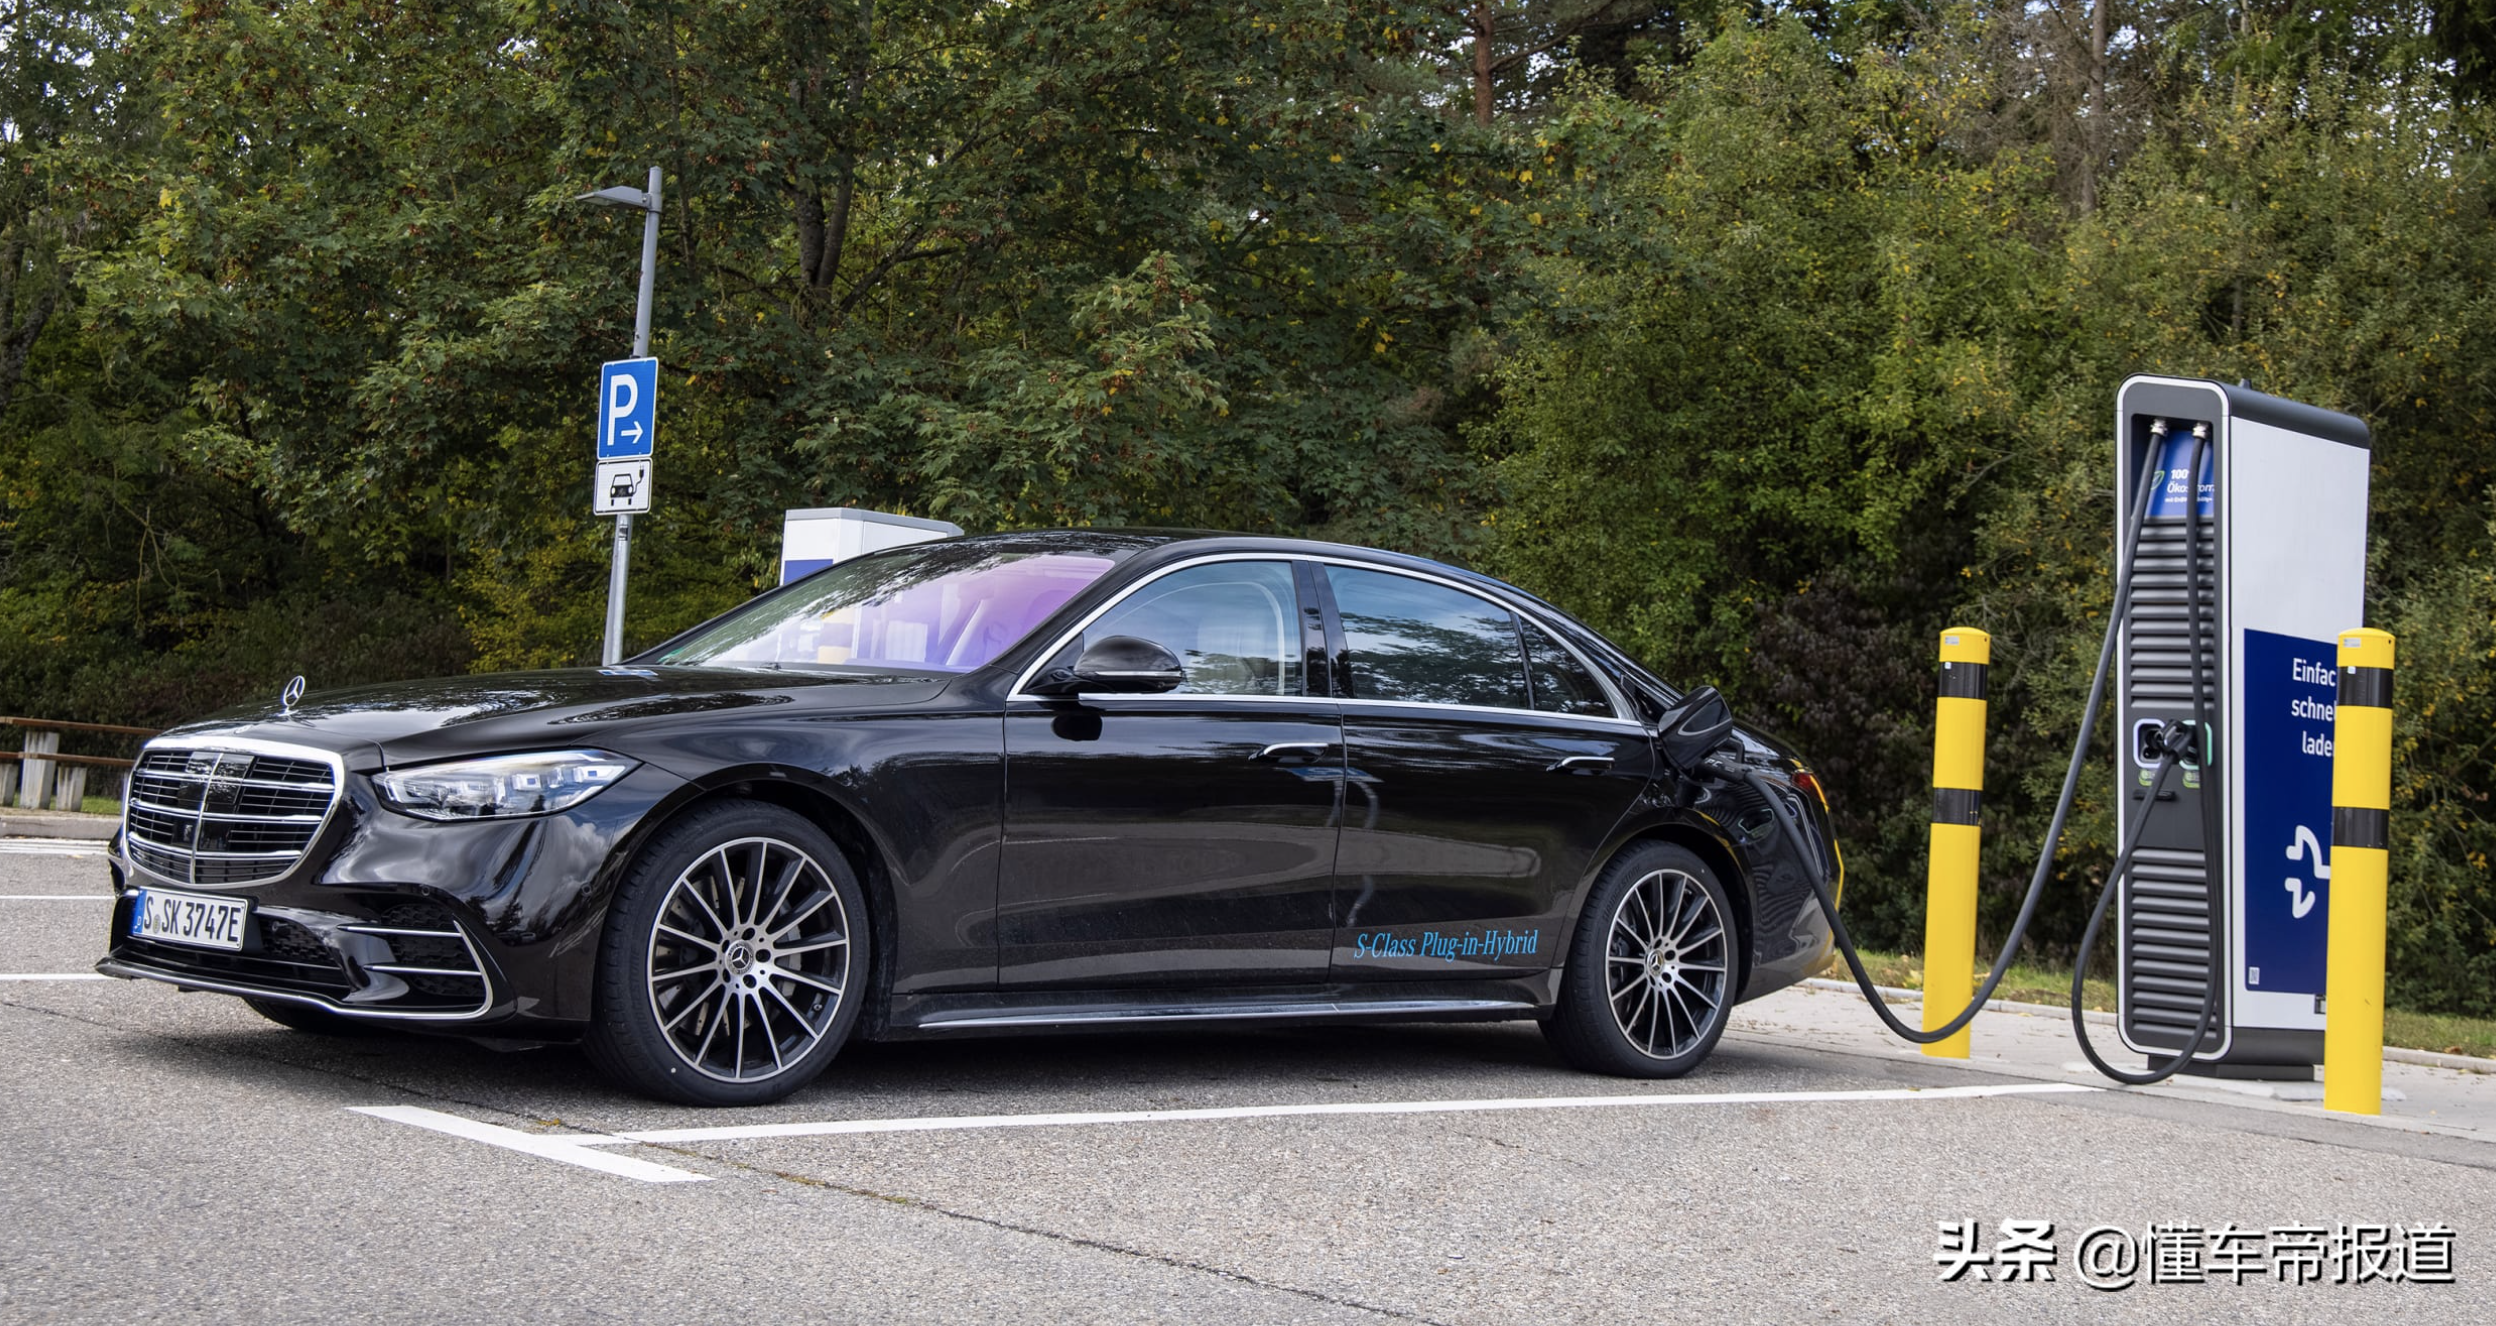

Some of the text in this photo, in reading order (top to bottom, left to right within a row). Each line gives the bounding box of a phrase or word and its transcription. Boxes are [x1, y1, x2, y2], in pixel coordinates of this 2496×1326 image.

[607, 373, 639, 446] P
[2171, 468, 2191, 480] 100
[2292, 657, 2337, 687] Einfac
[2302, 730, 2335, 758] lade
[161, 898, 182, 935] SK
[183, 901, 241, 942] 3747E
[1354, 929, 1539, 963] S-Class Plug-in-Hybrid
